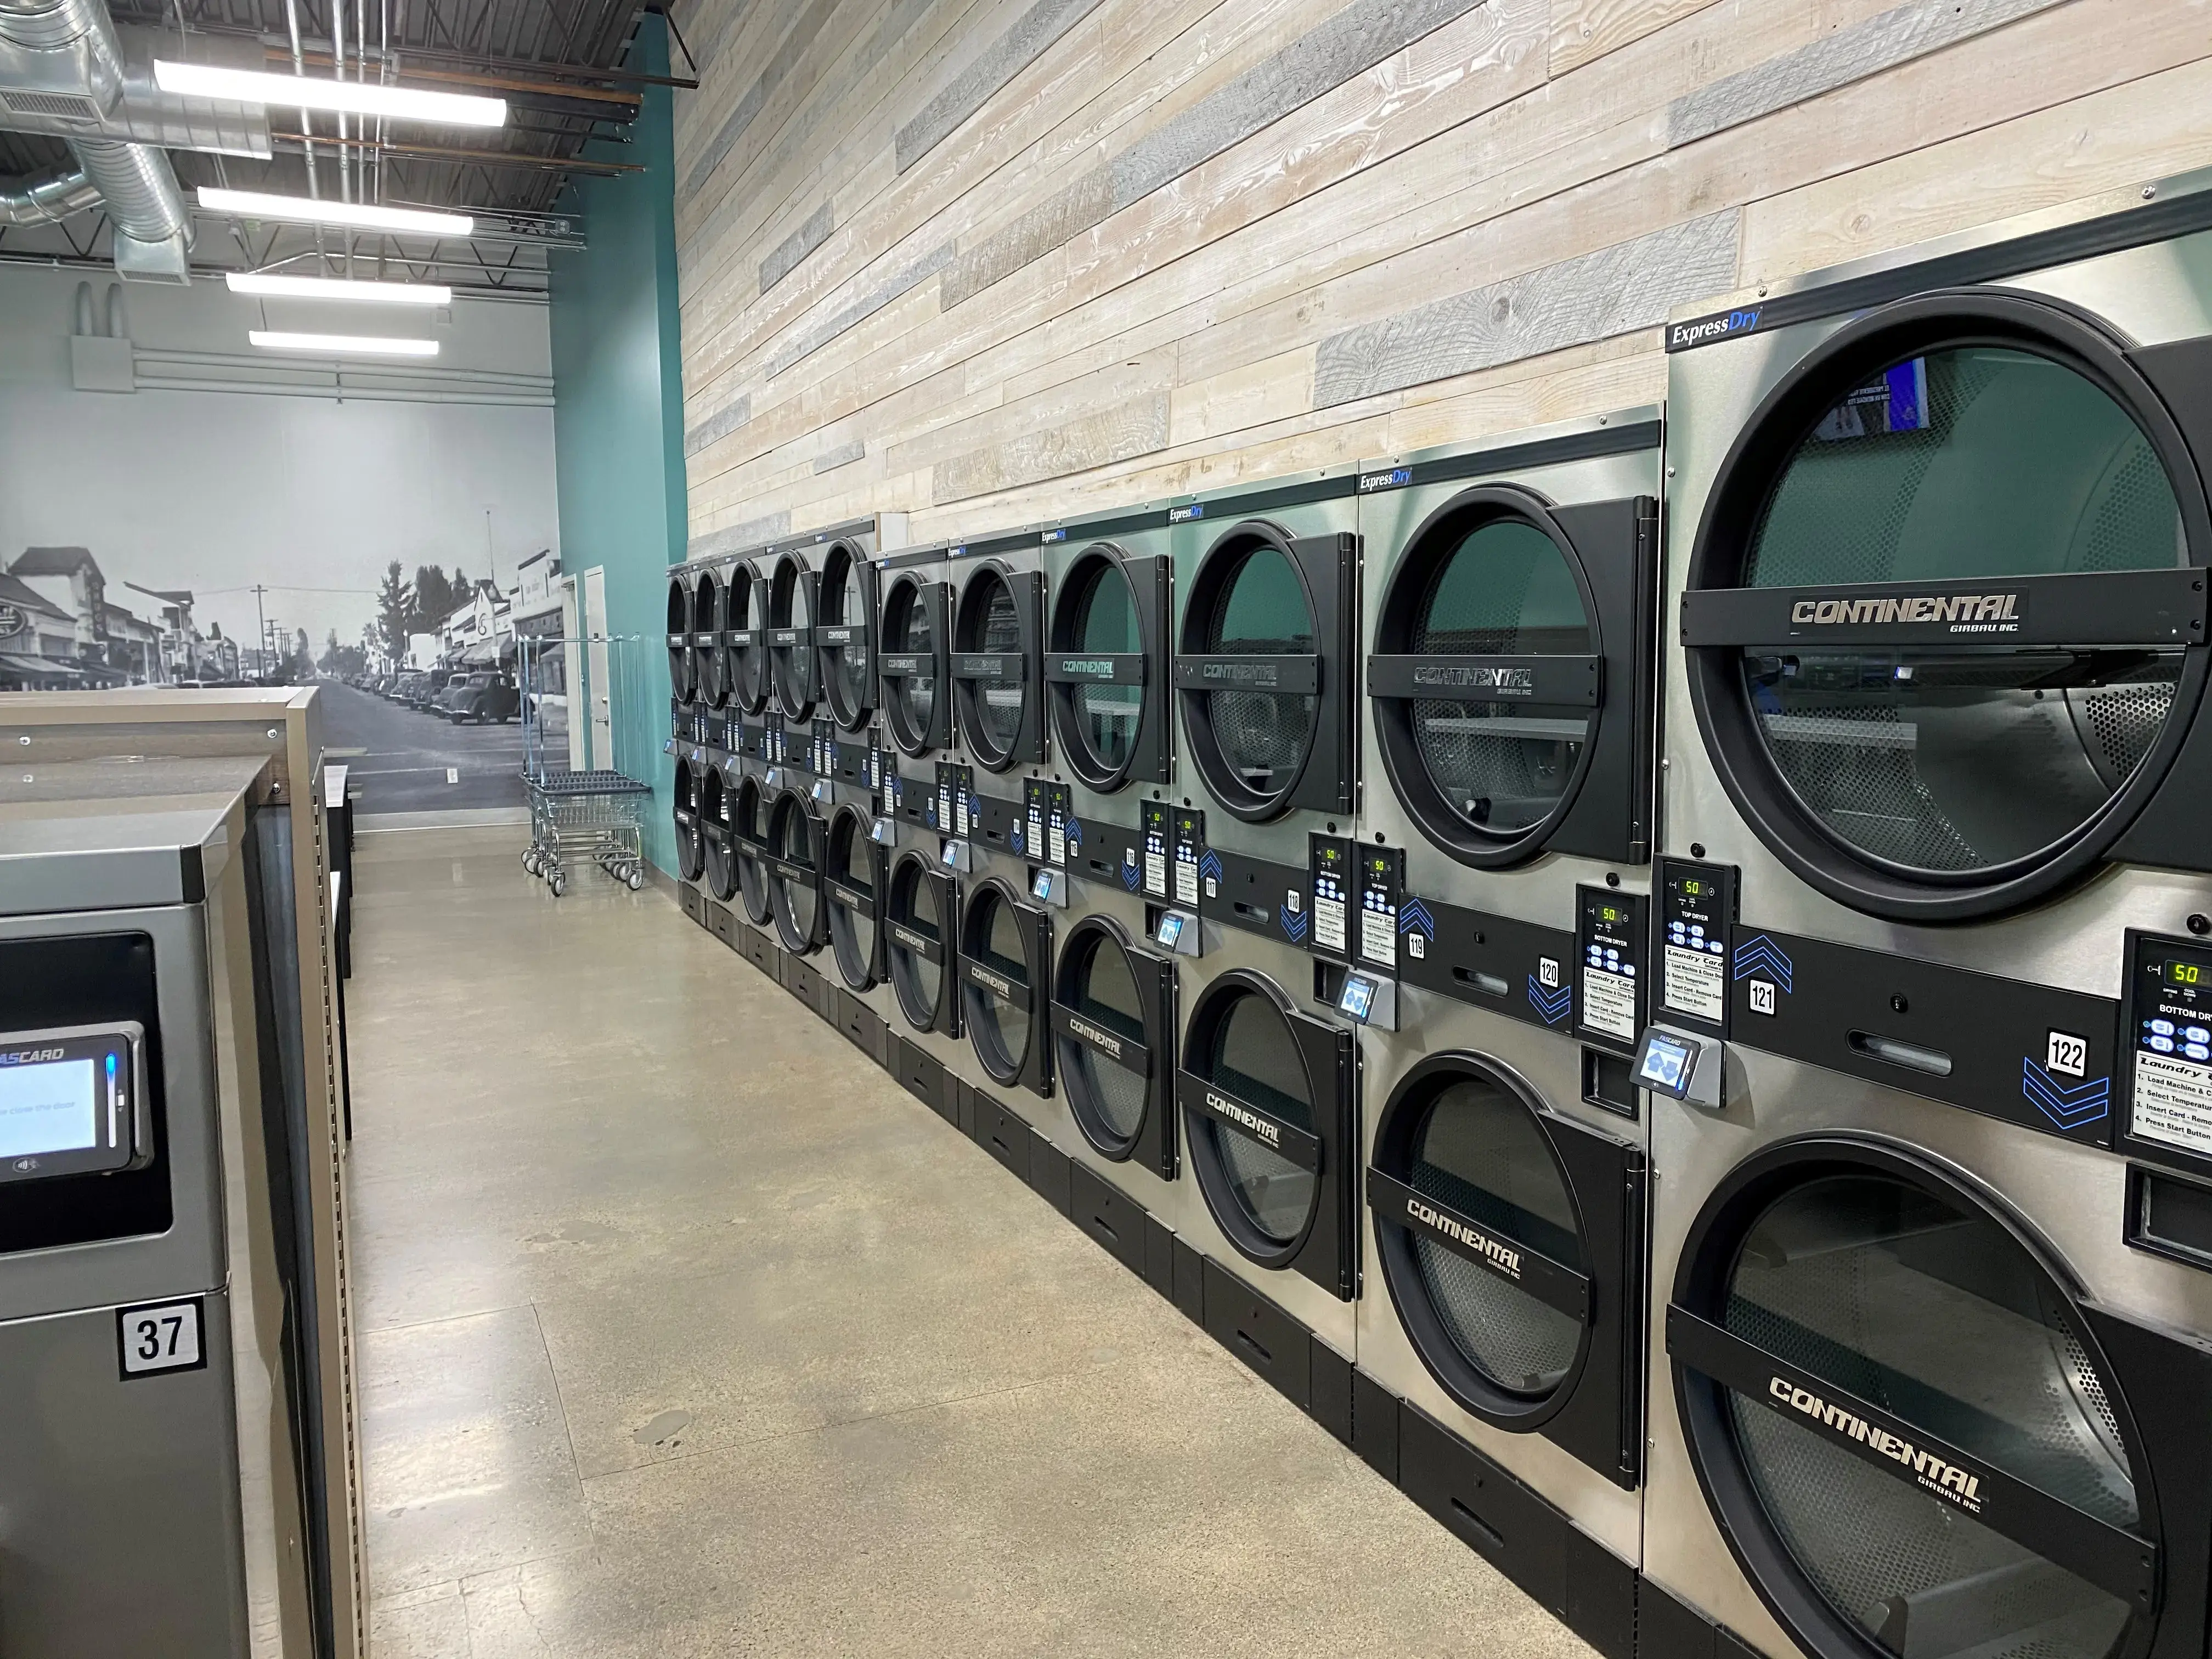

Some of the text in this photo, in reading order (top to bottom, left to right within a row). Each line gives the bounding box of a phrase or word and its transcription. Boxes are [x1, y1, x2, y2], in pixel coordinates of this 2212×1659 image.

[1672, 311, 1760, 346] ExpressDry
[1361, 470, 1411, 491] ExpressDry
[1792, 595, 2019, 624] CONTINENTAL
[1063, 661, 1113, 673] CONTINENTAL
[1414, 667, 1532, 687] CONTINENTAL
[1327, 850, 1334, 859] 50
[1376, 861, 1384, 870] 50
[1686, 881, 1699, 894] 50
[1289, 894, 1298, 909] 118
[1604, 908, 1615, 920] 50
[1692, 913, 1708, 922] DRYER
[1411, 938, 1422, 955] 119
[1594, 934, 1627, 947] BOTTOM DRYER
[1668, 950, 1700, 962] Laundry
[1542, 962, 1556, 983] 120
[1586, 972, 1615, 984] Laundry
[2175, 964, 2198, 983] 50
[1685, 977, 1709, 986] Temperature
[1753, 985, 1771, 1009] 121
[2159, 1005, 2196, 1018] BOTTOM
[2052, 1040, 2083, 1069] 122
[2141, 1057, 2202, 1077] Laundry
[2148, 1075, 2164, 1085] Load
[2166, 1081, 2196, 1092] Machine
[2147, 1090, 2169, 1100] Select
[1206, 1093, 1279, 1142] CONTINENTAL
[2146, 1104, 2166, 1114] Insert
[2169, 1110, 2185, 1118] Card
[2146, 1118, 2164, 1127] Press
[2167, 1123, 2184, 1133] Start
[2187, 1128, 2210, 1140] Button
[1407, 1199, 1521, 1272] CONTINENTAL
[137, 1316, 183, 1360] 37
[1770, 1376, 1981, 1503] CONTINENTAL
